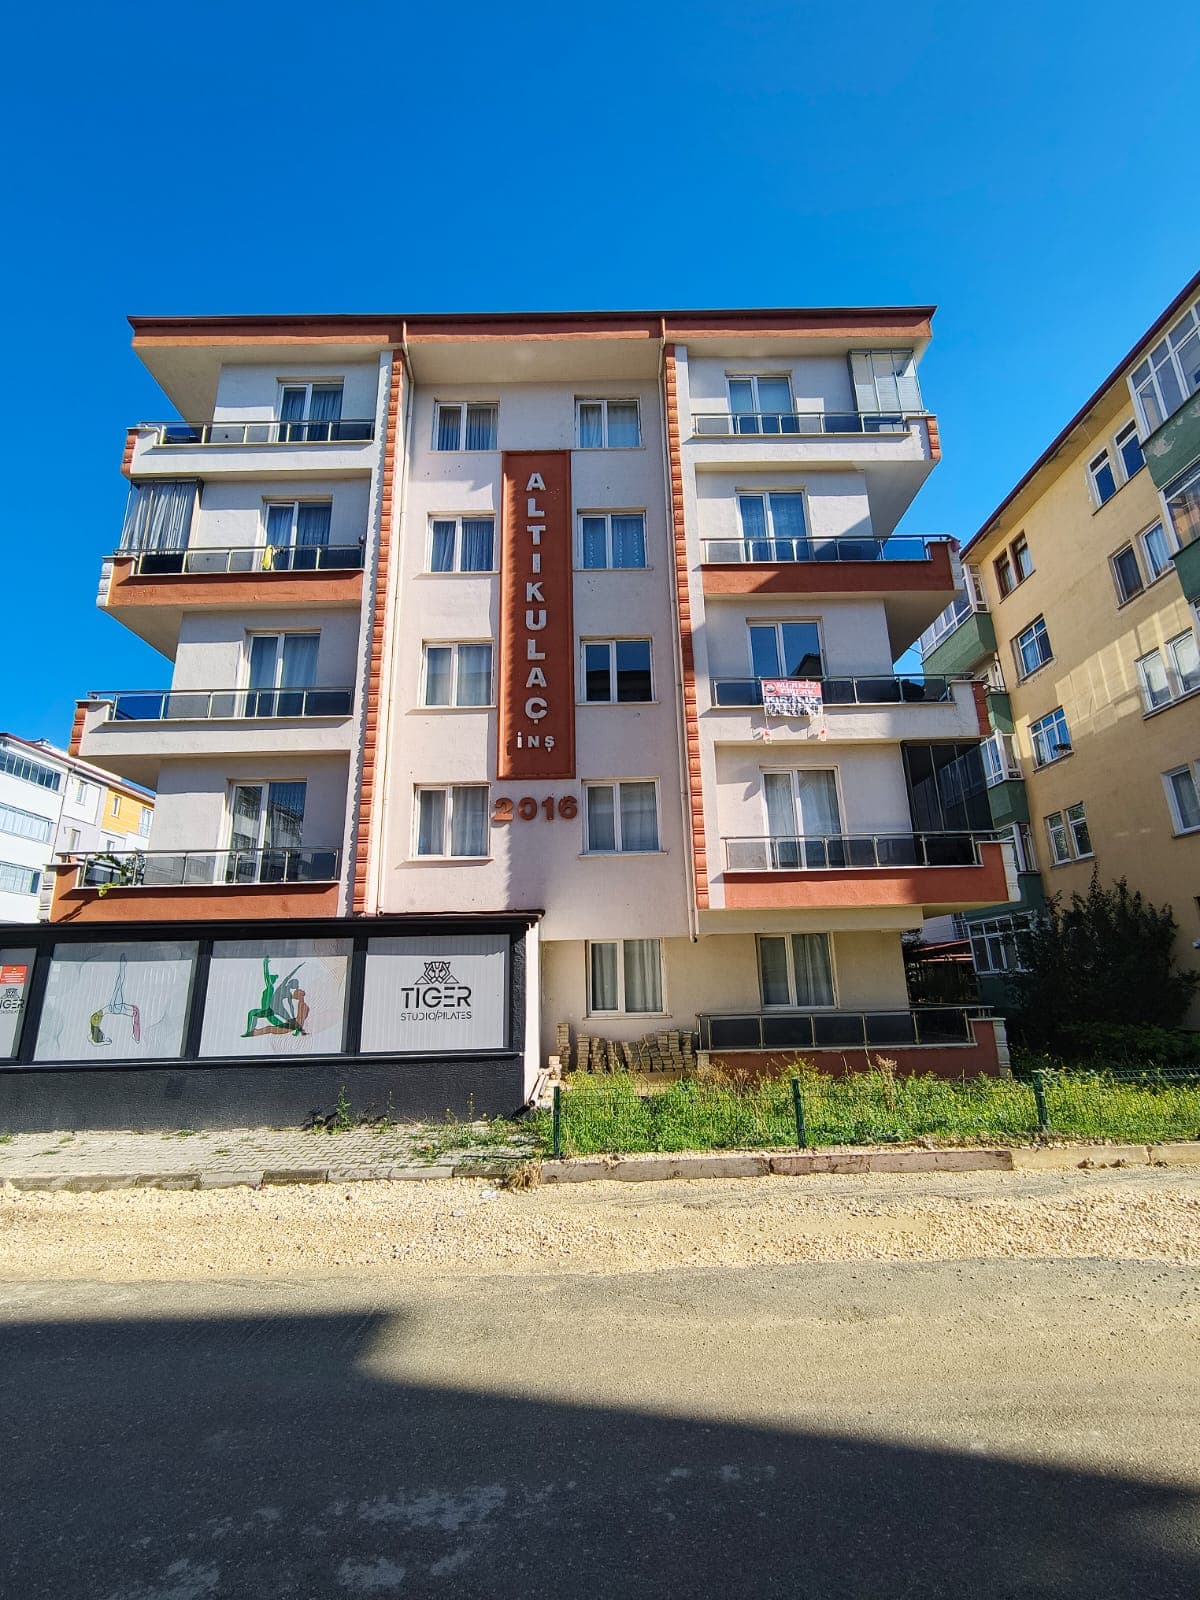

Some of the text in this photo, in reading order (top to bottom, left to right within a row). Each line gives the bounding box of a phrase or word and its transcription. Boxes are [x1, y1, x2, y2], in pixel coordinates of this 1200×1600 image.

[525, 472, 548, 724] ALTIKULAÇ
[493, 795, 578, 822] 2016
[401, 986, 472, 1008] TIGER
